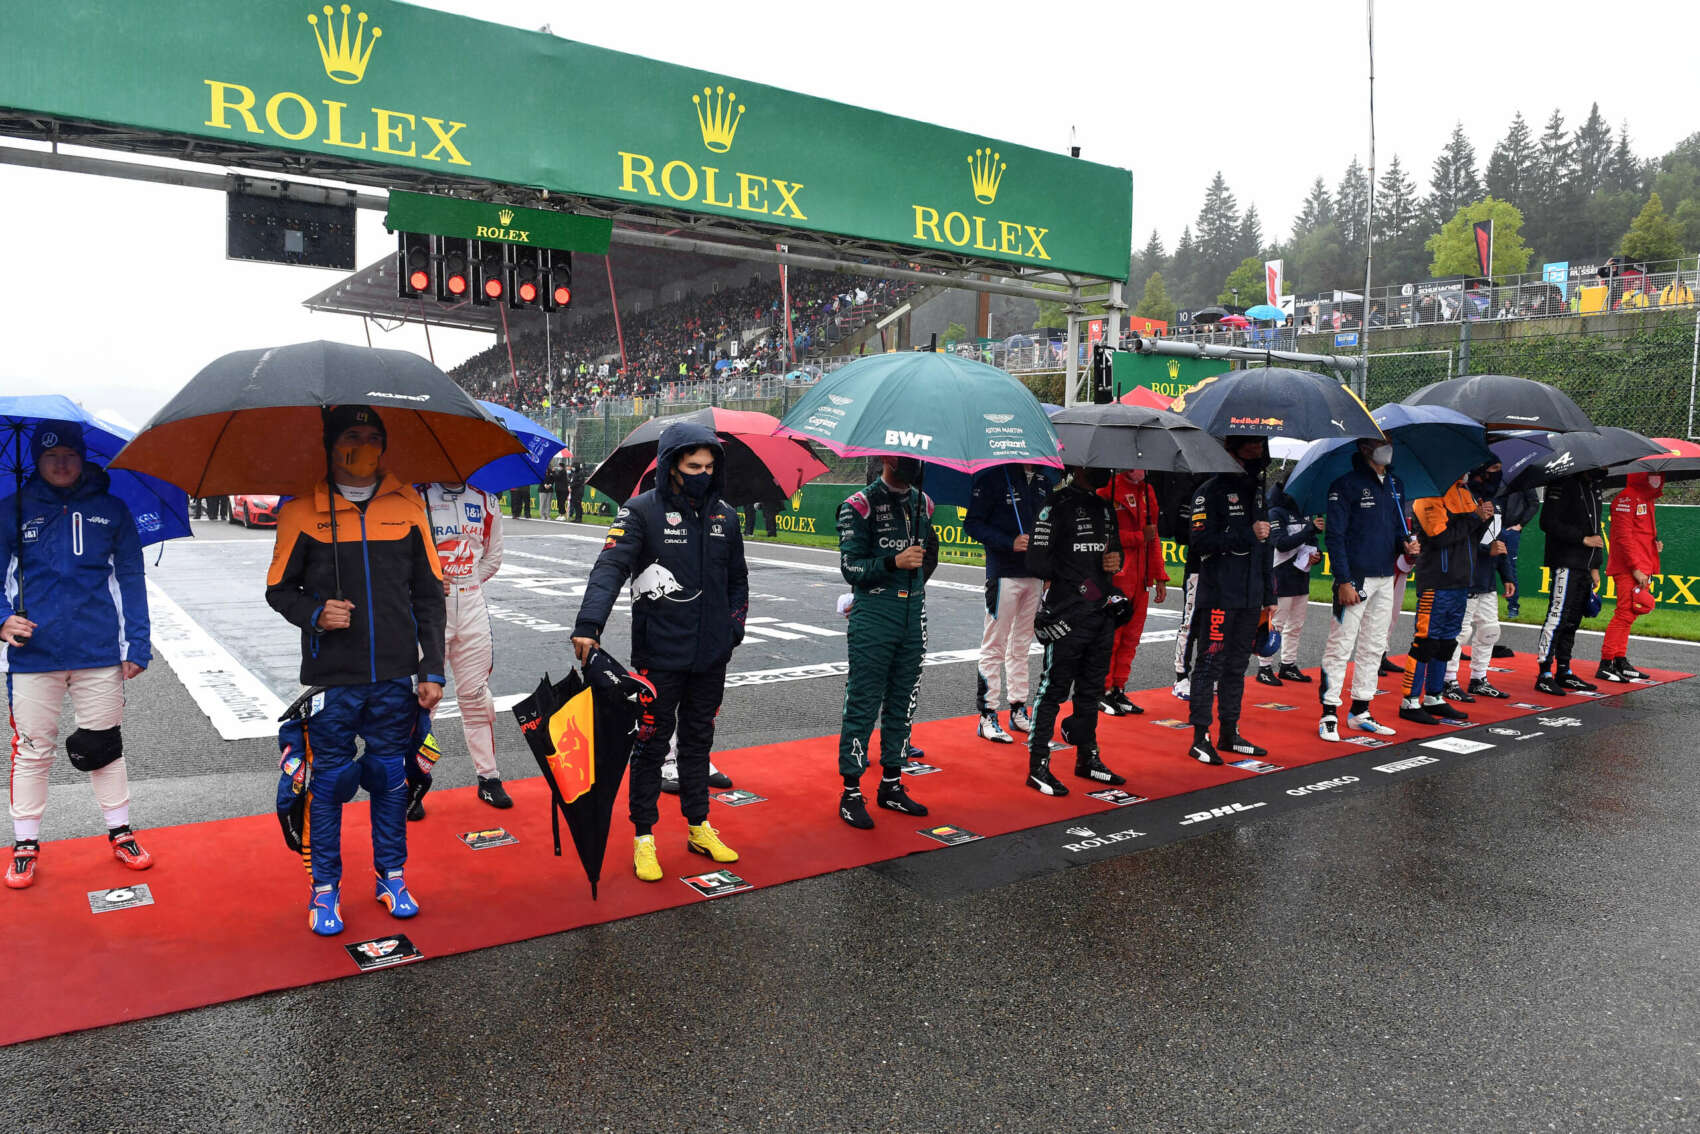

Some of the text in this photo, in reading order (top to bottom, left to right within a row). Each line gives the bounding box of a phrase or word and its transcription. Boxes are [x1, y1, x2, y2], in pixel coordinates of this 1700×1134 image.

[204, 79, 471, 167] ROLEX
[617, 151, 808, 220] ROLEX
[476, 225, 530, 243] ROLEX
[912, 204, 1052, 261] ROLEX
[1282, 300, 1291, 308] 7
[1179, 312, 1188, 322] 10
[1230, 416, 1260, 425] Red Bull
[885, 430, 932, 450] BWT
[989, 440, 1027, 450] Cognizant
[775, 514, 816, 533] ROLEX
[932, 525, 985, 545] ROL
[1073, 543, 1107, 552] PETRO
[1371, 755, 1440, 774] PIRELLI
[1090, 769, 1112, 782] PUMA
[1286, 775, 1360, 797] aramco
[1186, 803, 1257, 824] DHL
[1062, 829, 1147, 852] ROLEX
